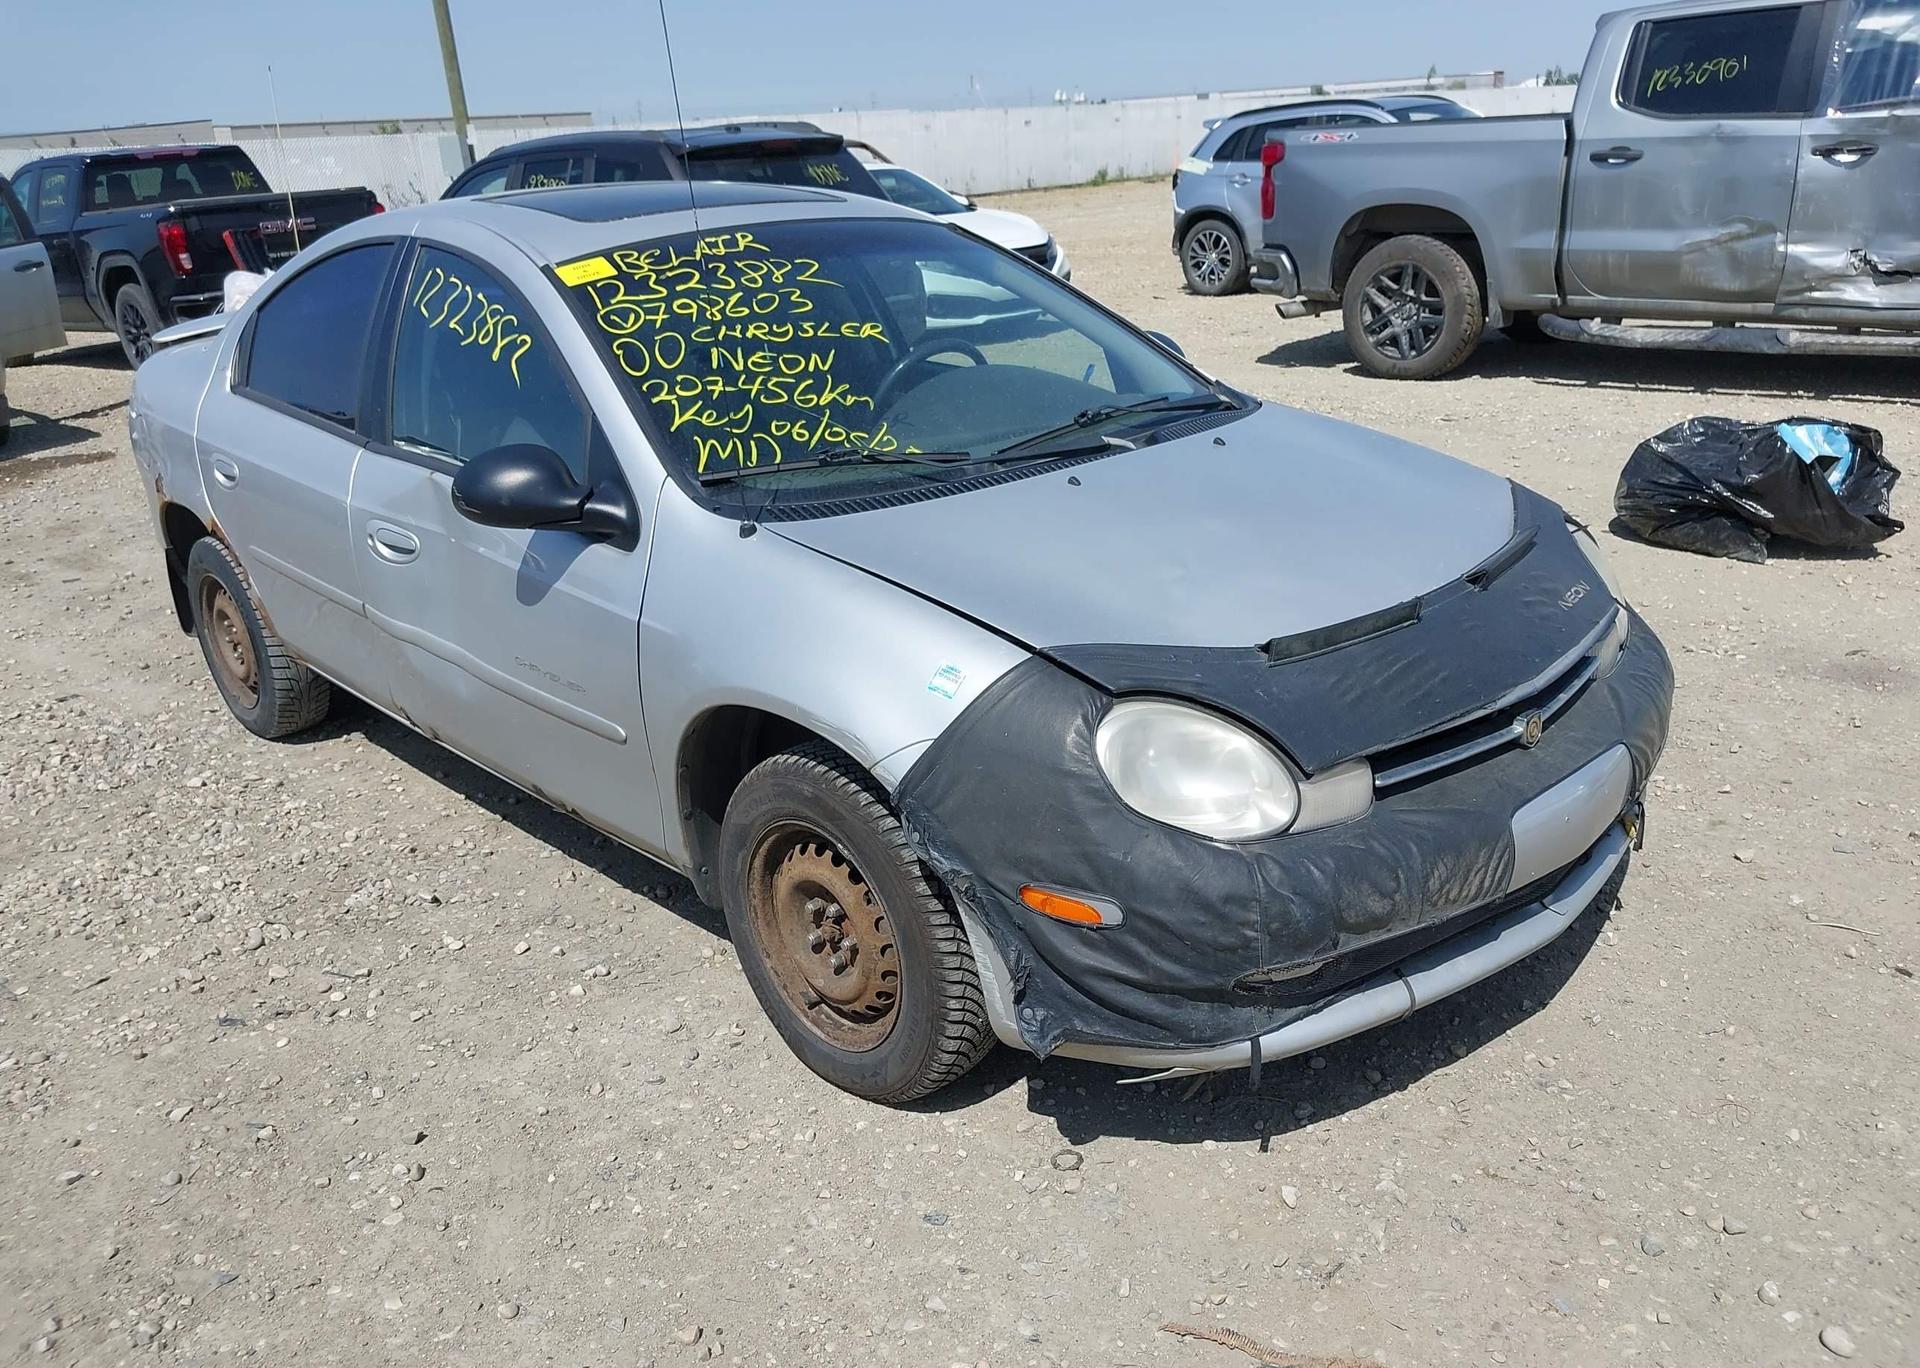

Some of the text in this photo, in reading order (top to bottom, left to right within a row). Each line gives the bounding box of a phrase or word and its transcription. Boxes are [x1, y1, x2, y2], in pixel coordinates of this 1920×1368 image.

[259, 217, 317, 234] GMC
[587, 259, 845, 311] 12323882
[691, 322, 890, 343] CHRYSLER
[710, 346, 836, 374] NEON
[1558, 580, 1591, 611] NEON
